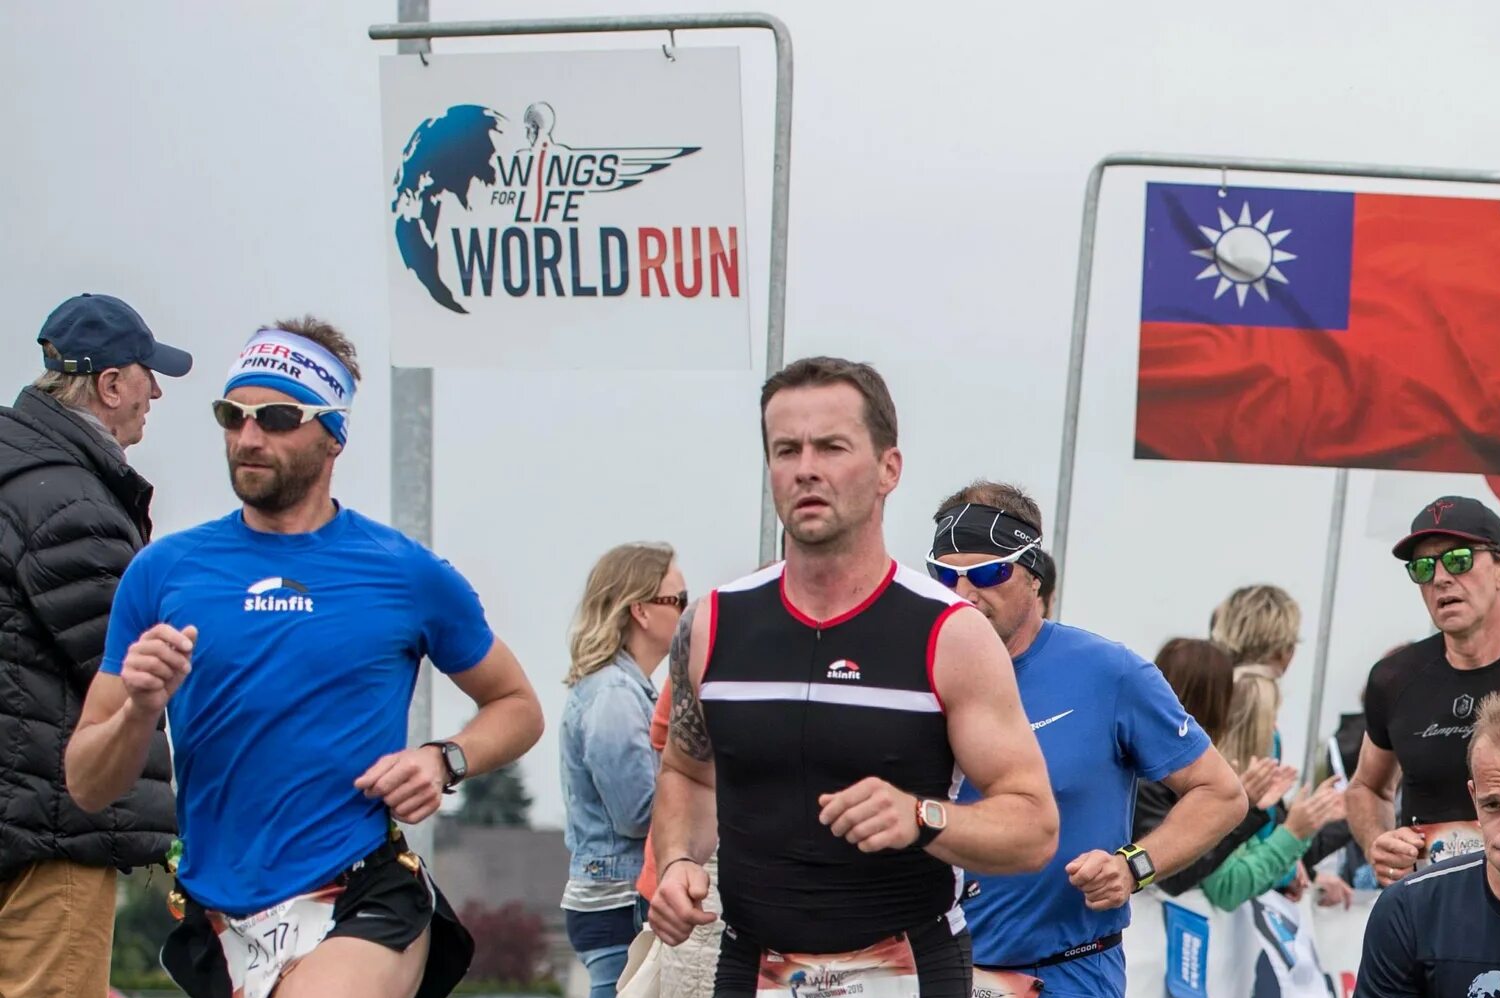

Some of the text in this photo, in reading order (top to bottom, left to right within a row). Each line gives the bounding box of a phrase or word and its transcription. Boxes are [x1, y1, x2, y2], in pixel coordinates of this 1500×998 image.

[490, 190, 584, 224] FOR LIFE
[451, 226, 740, 299] WORLD RUN
[241, 356, 302, 379] PINTAR
[244, 595, 314, 612] skinfit
[826, 670, 861, 680] skinfit
[971, 988, 992, 998] NGS
